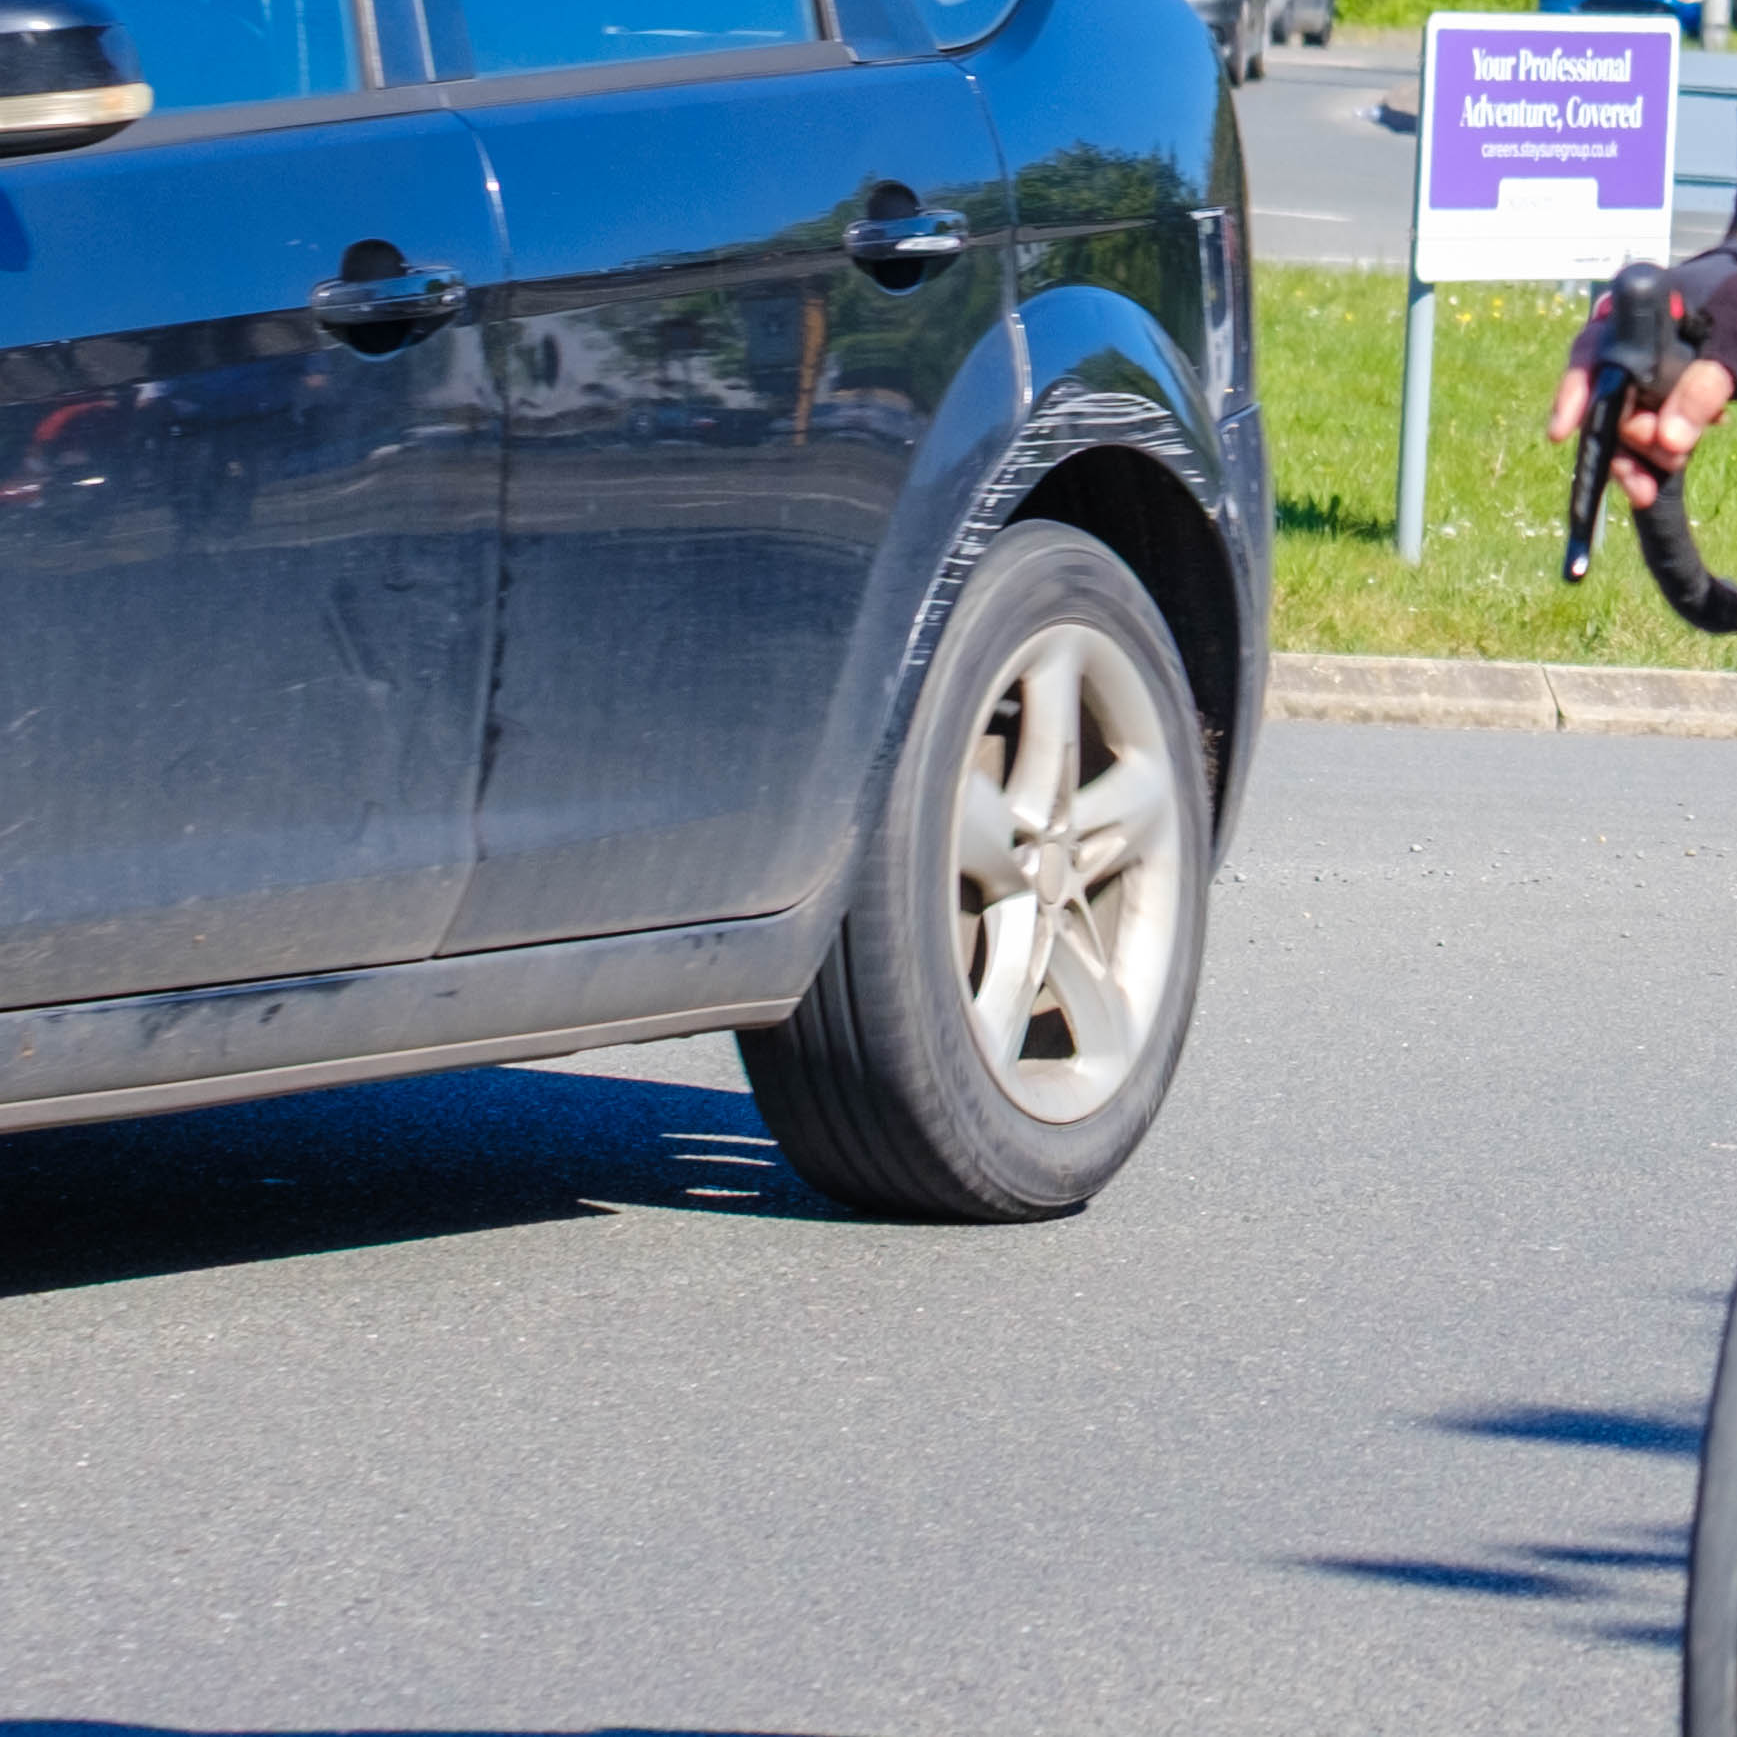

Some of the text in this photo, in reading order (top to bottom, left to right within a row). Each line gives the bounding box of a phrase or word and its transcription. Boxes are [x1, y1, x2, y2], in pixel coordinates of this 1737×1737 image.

[1472, 48, 1632, 82] Your Professional
[1460, 94, 1644, 132] Adventure, Covered
